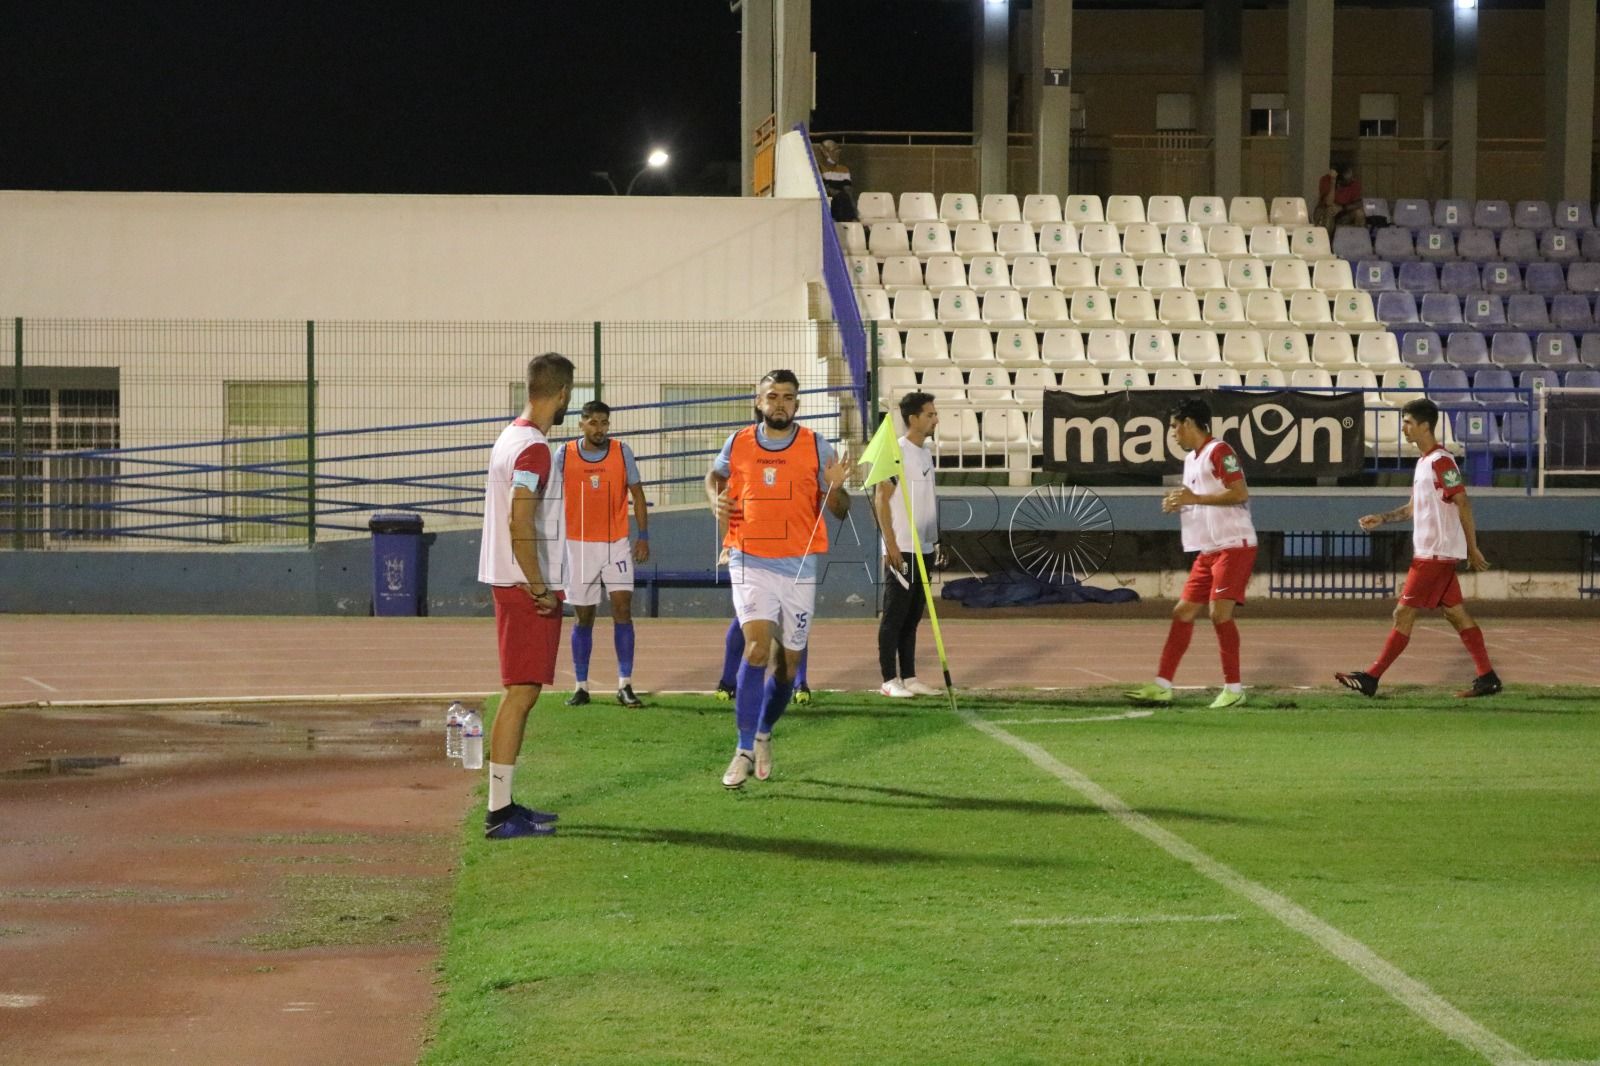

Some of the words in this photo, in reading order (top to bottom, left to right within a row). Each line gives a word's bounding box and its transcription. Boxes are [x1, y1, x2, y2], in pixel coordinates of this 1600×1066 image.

[1053, 403, 1343, 464] maron
[615, 560, 628, 573] 17
[795, 611, 808, 629] 15
